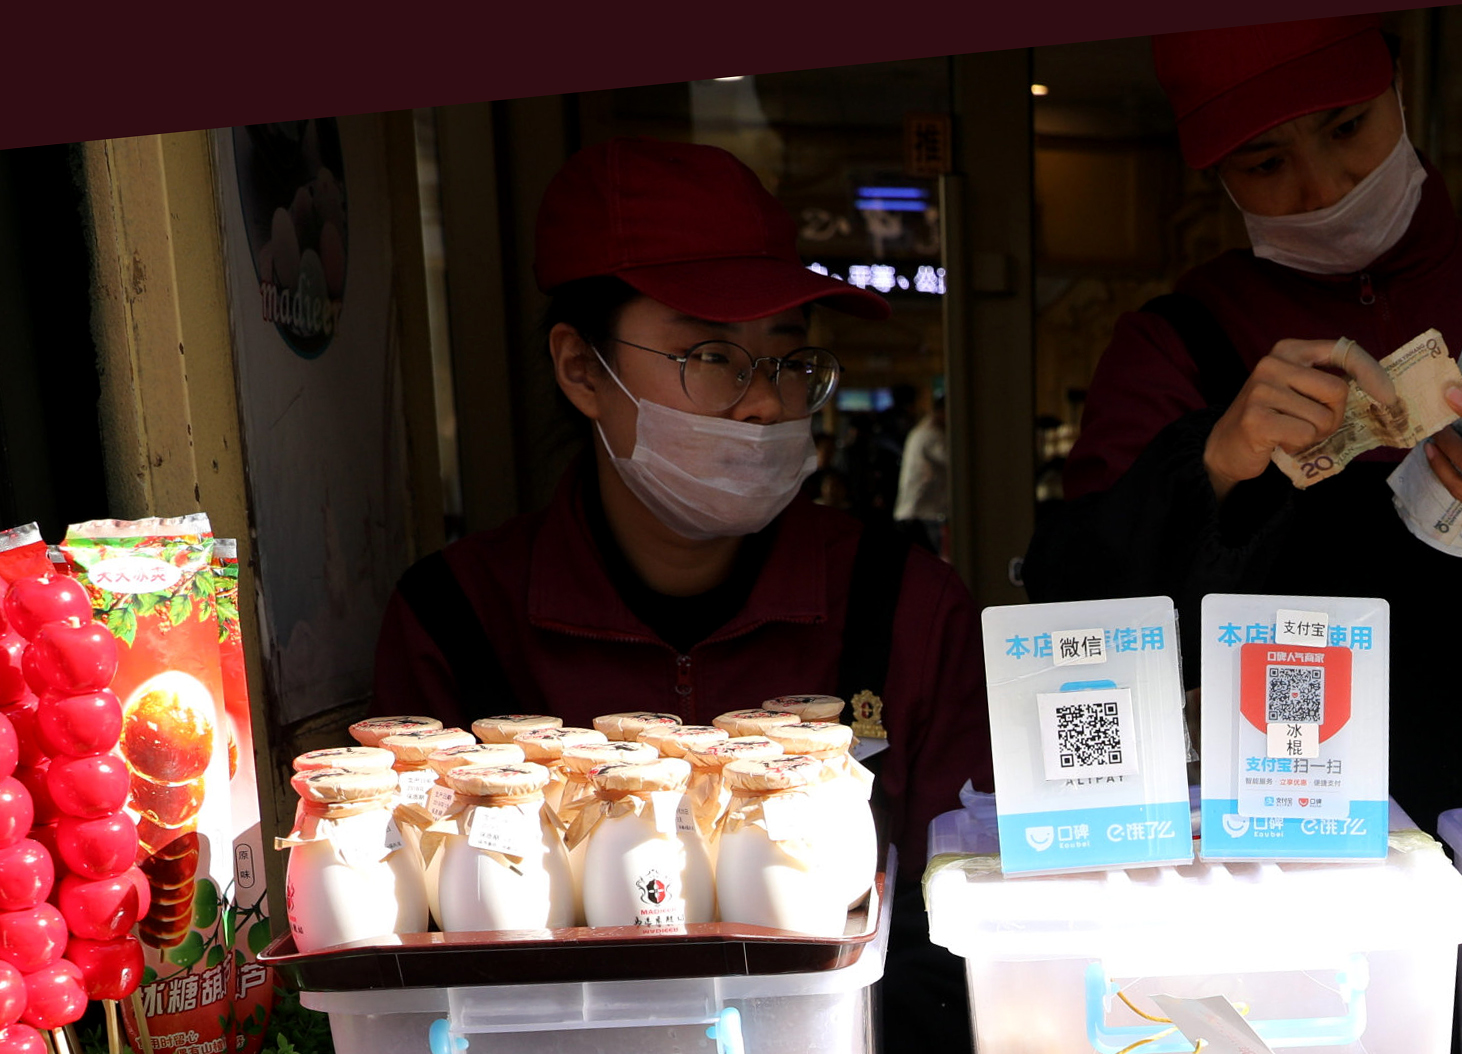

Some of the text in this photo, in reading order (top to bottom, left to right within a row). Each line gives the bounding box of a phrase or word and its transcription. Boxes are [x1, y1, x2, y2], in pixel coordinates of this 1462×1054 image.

[1301, 455, 1334, 479] 20
[1218, 622, 1373, 650] 本店使用
[1283, 620, 1326, 638] 支付宝
[1005, 625, 1165, 660] 本店使用
[1059, 635, 1102, 659] 微信
[1245, 757, 1342, 774] 支付宝扫一扫
[1058, 823, 1090, 842] 口碑
